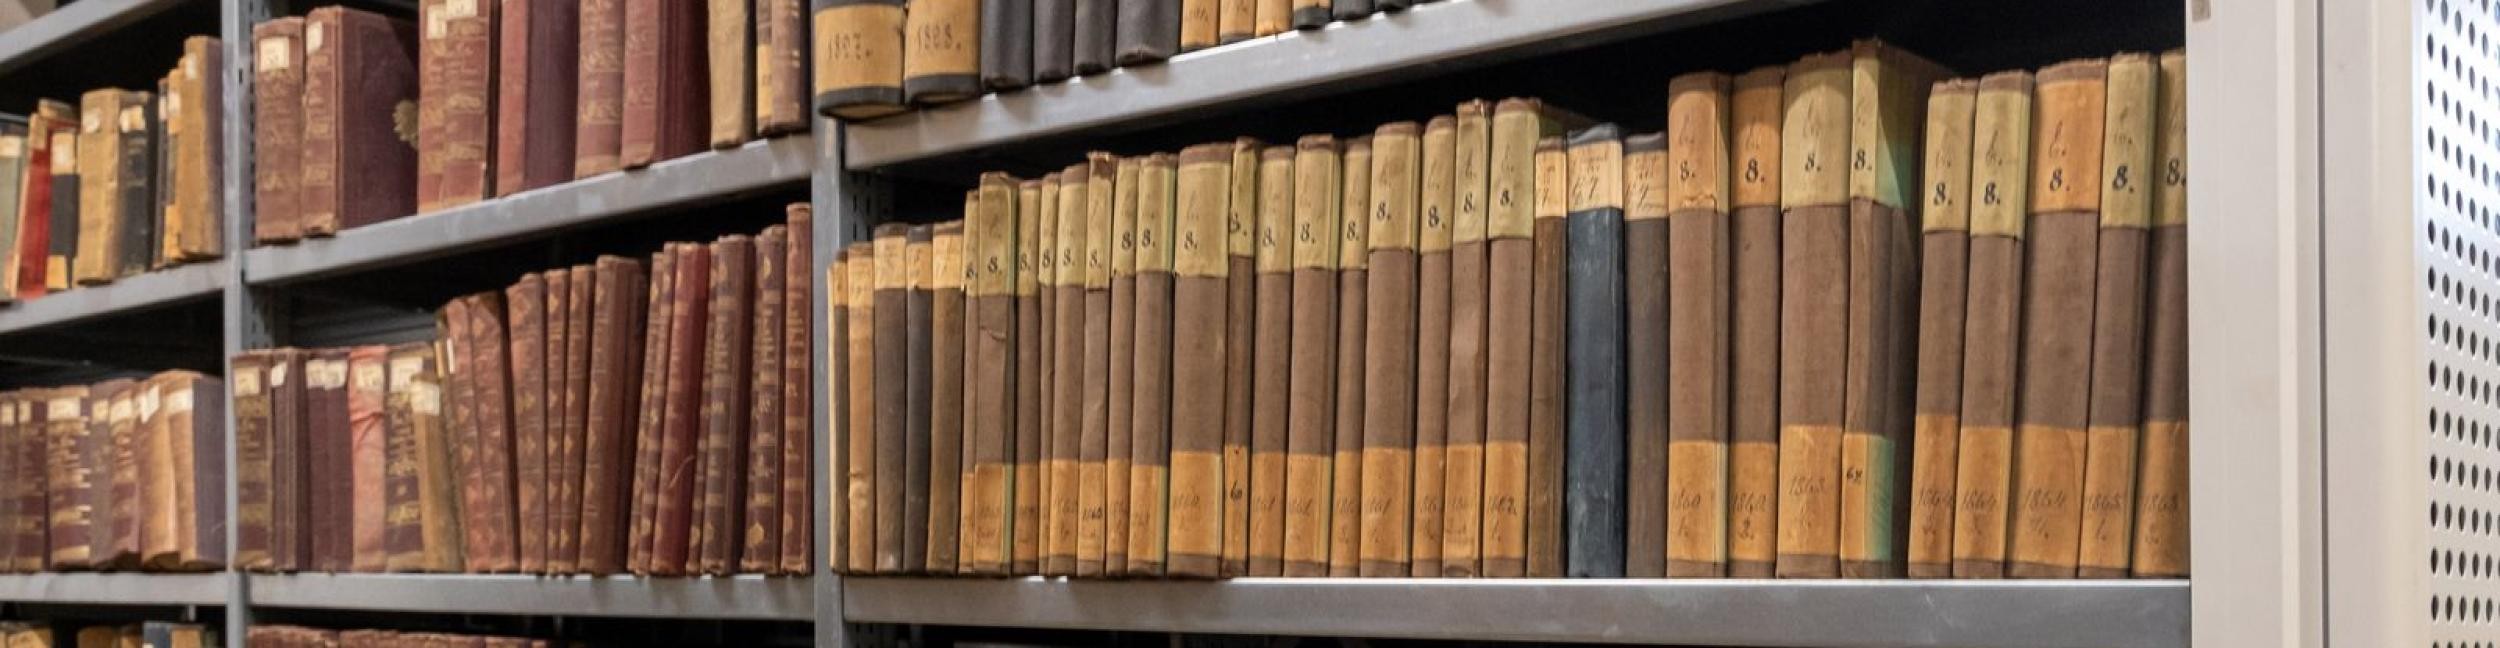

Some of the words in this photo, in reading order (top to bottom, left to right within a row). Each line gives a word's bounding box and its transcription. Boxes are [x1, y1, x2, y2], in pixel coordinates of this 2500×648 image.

[1745, 158, 1766, 184] 8.
[1854, 149, 1873, 170] 8.
[2049, 167, 2072, 192] 8.
[2111, 164, 2134, 194] 8.
[1933, 182, 1952, 206] 8.
[1983, 181, 2001, 205] 8.
[1376, 202, 1391, 221] 8.
[1427, 205, 1446, 229] 8.
